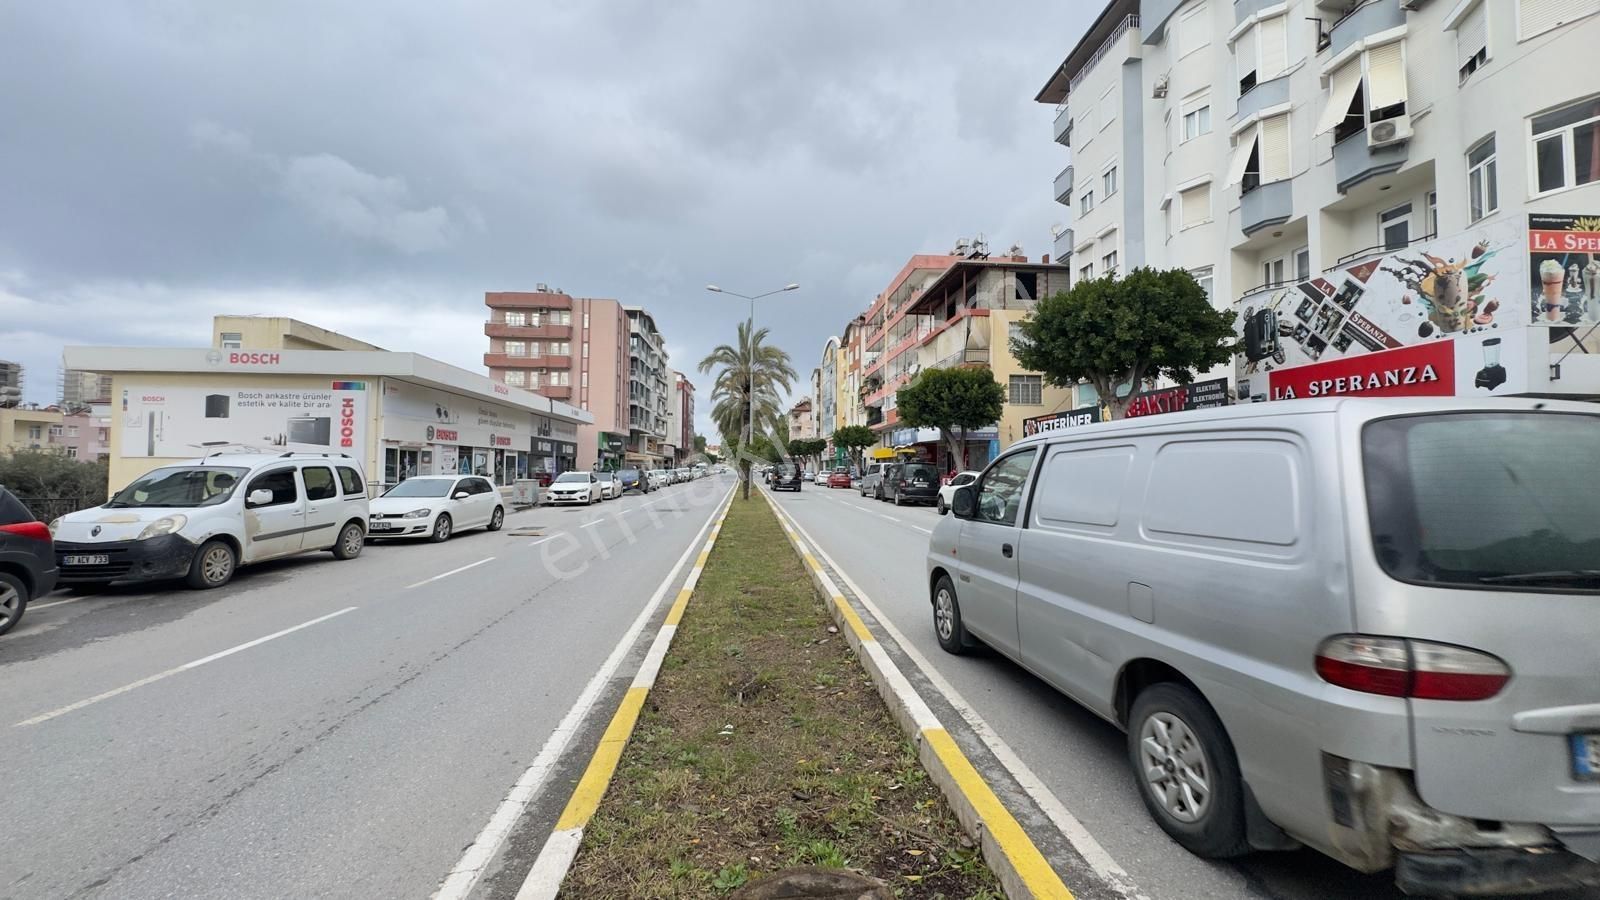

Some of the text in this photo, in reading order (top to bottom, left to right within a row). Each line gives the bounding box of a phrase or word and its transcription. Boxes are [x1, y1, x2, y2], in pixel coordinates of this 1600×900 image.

[1534, 233, 1600, 250] LA SPE
[1320, 282, 1331, 295] LA
[1351, 313, 1387, 344] SPERANZA
[229, 353, 280, 365] BOSCH
[1274, 364, 1439, 401] LA SPERANZA
[237, 399, 265, 408] estetik
[279, 399, 302, 408] kalite
[303, 399, 315, 408] bir
[238, 391, 263, 399] Bosch
[265, 392, 300, 400] ankastre
[340, 397, 354, 448] BOSCH
[1036, 412, 1093, 435] VETERİNER
[435, 428, 458, 441] BOSCH
